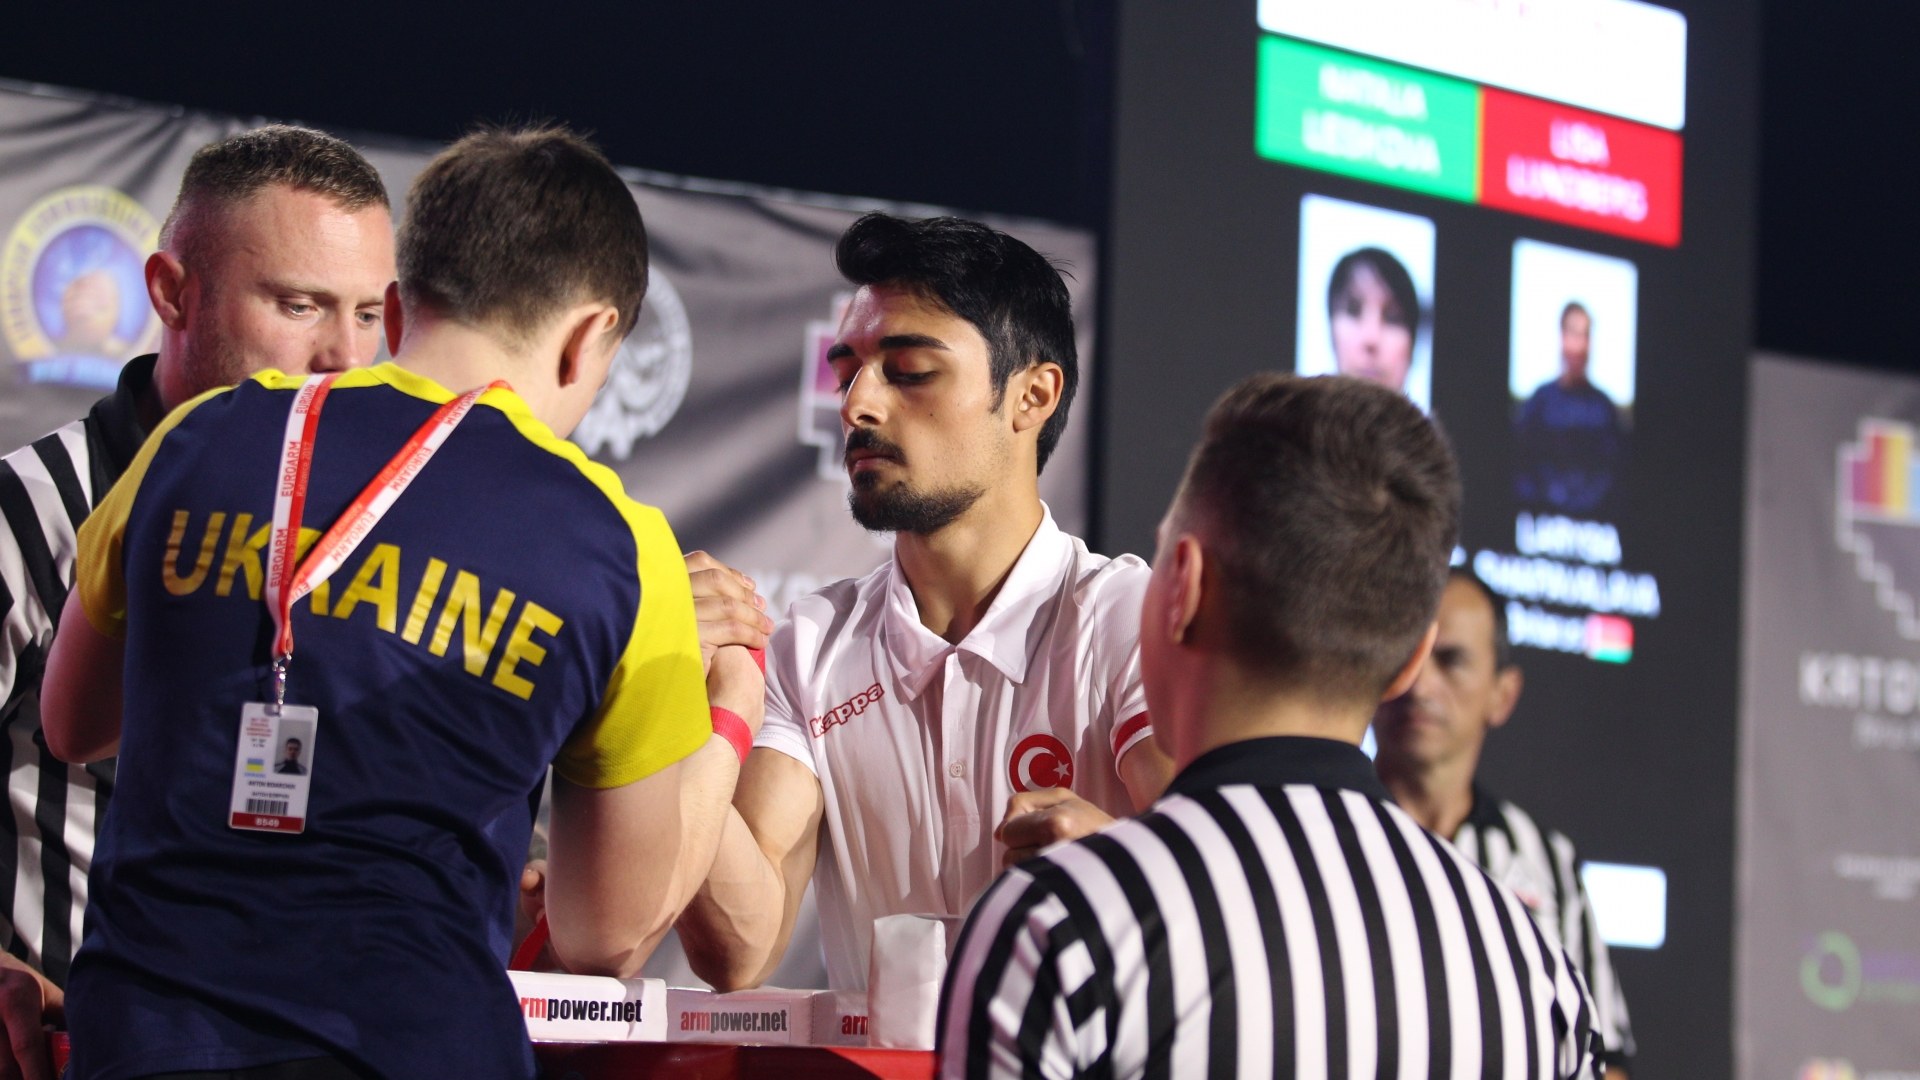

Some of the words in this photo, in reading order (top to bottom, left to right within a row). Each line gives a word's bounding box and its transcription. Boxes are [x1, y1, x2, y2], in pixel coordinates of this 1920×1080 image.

[281, 441, 301, 497] EUROARM
[390, 447, 433, 491] EUROARM
[270, 528, 288, 588] EUROARM
[331, 511, 376, 561] EUROARM
[1801, 655, 1920, 714] KATO
[521, 997, 642, 1023] rmpower.net
[681, 1010, 787, 1033] armpower.net
